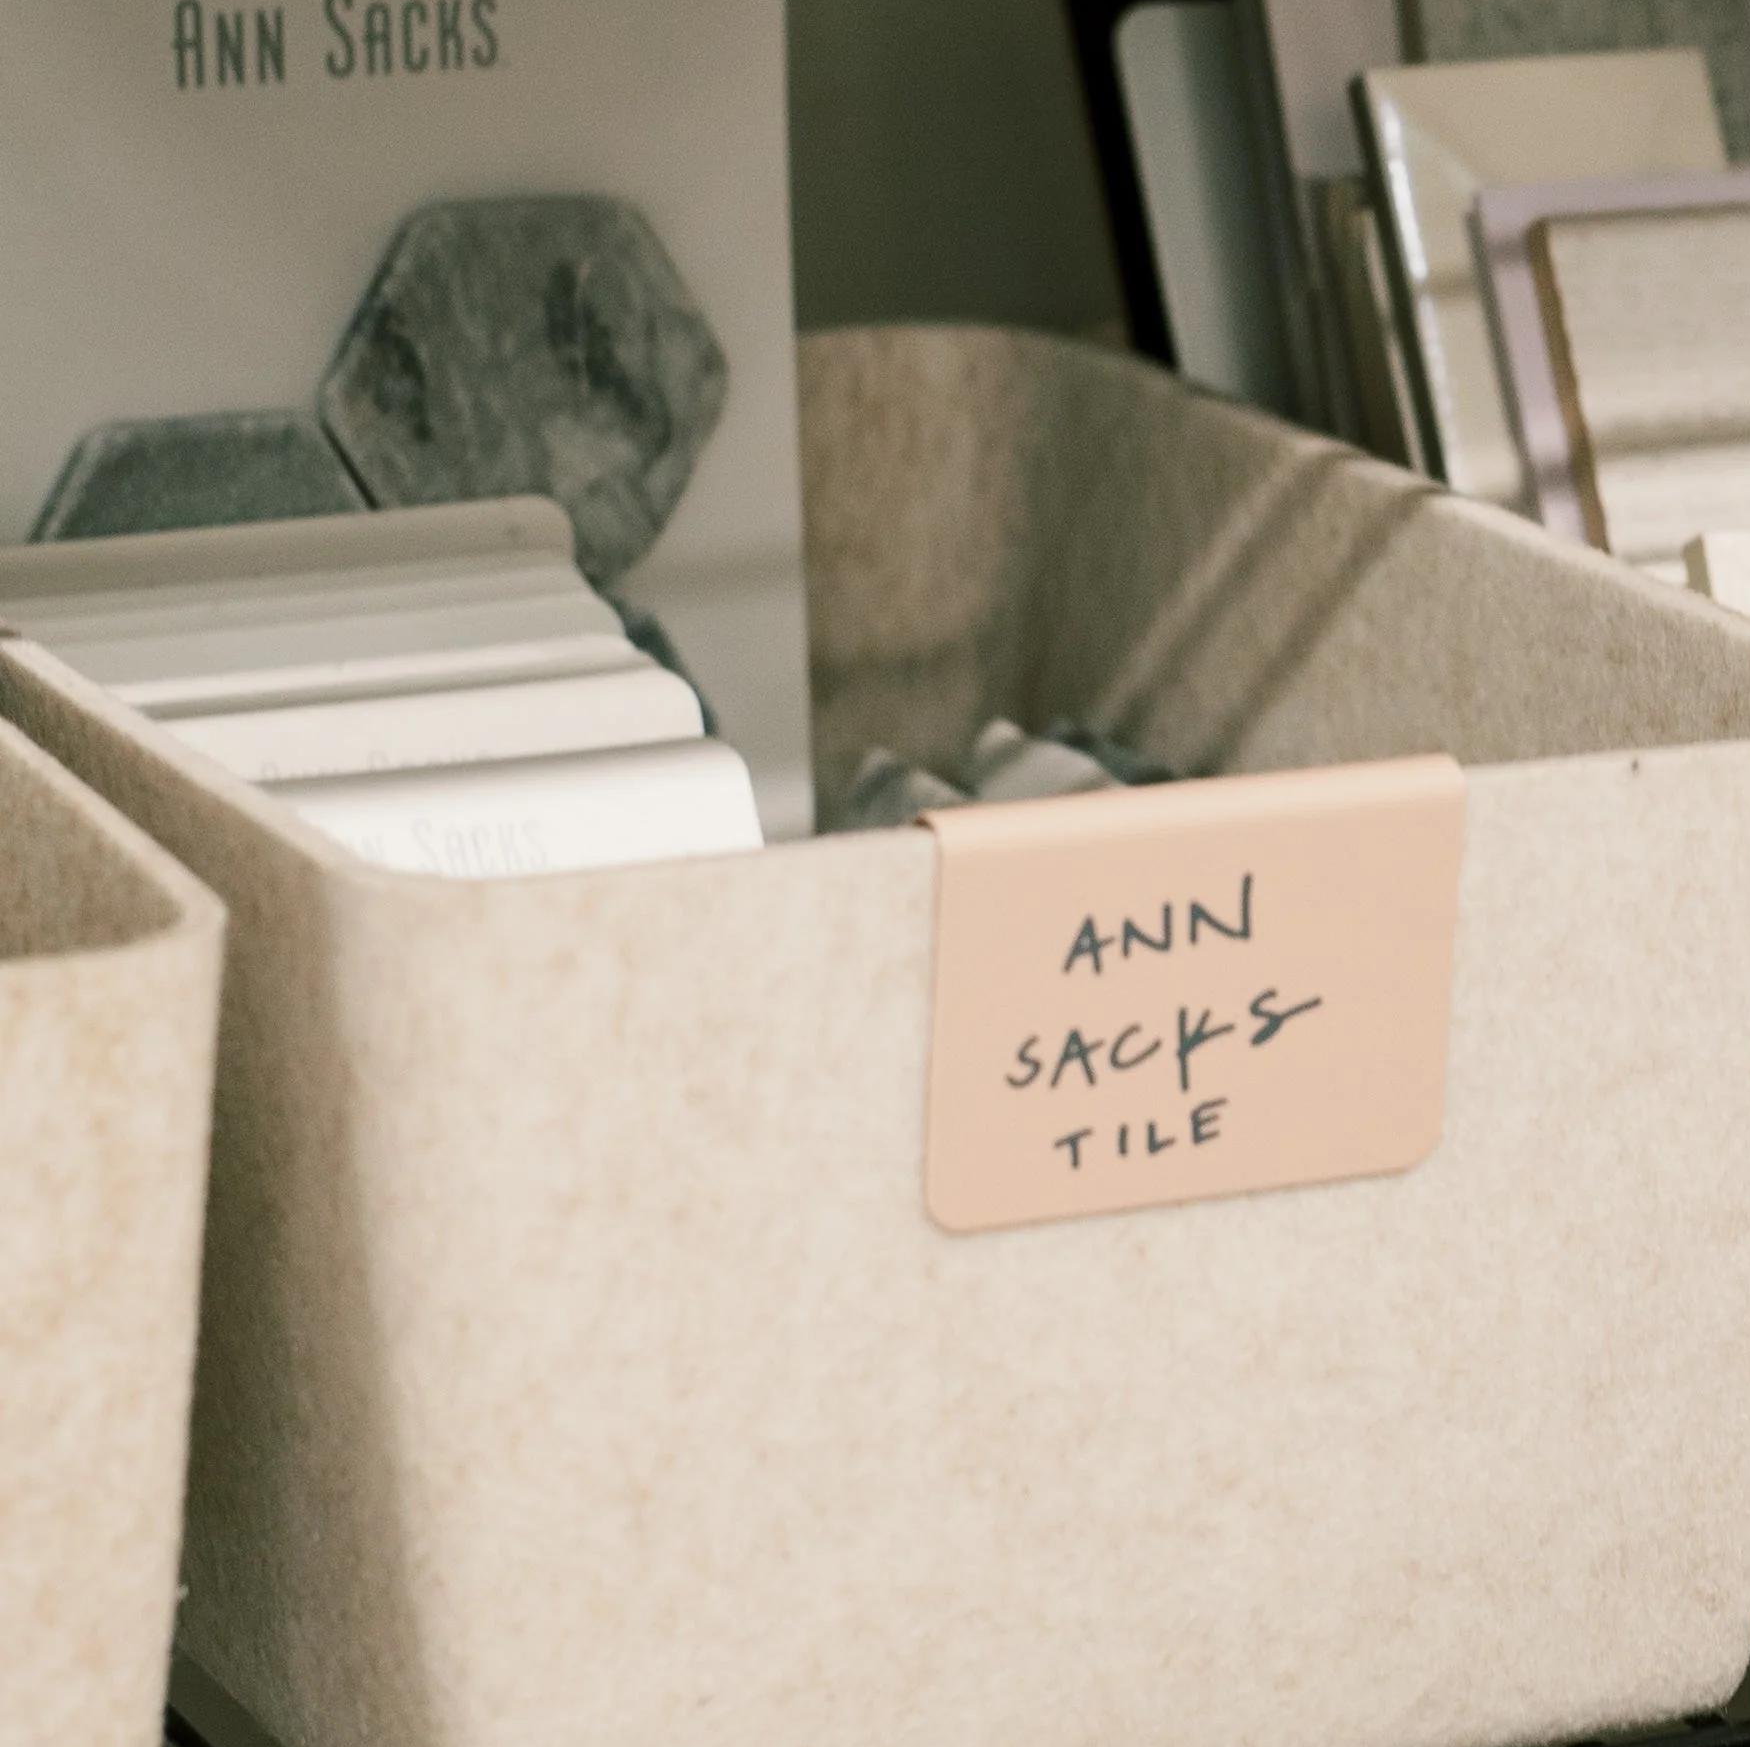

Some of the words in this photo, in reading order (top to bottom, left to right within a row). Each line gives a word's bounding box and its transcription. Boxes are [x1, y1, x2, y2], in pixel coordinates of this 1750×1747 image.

[1062, 870, 1253, 975] ANN
[1005, 988, 1323, 1092] SACKS
[1053, 1096, 1229, 1170] TILE
